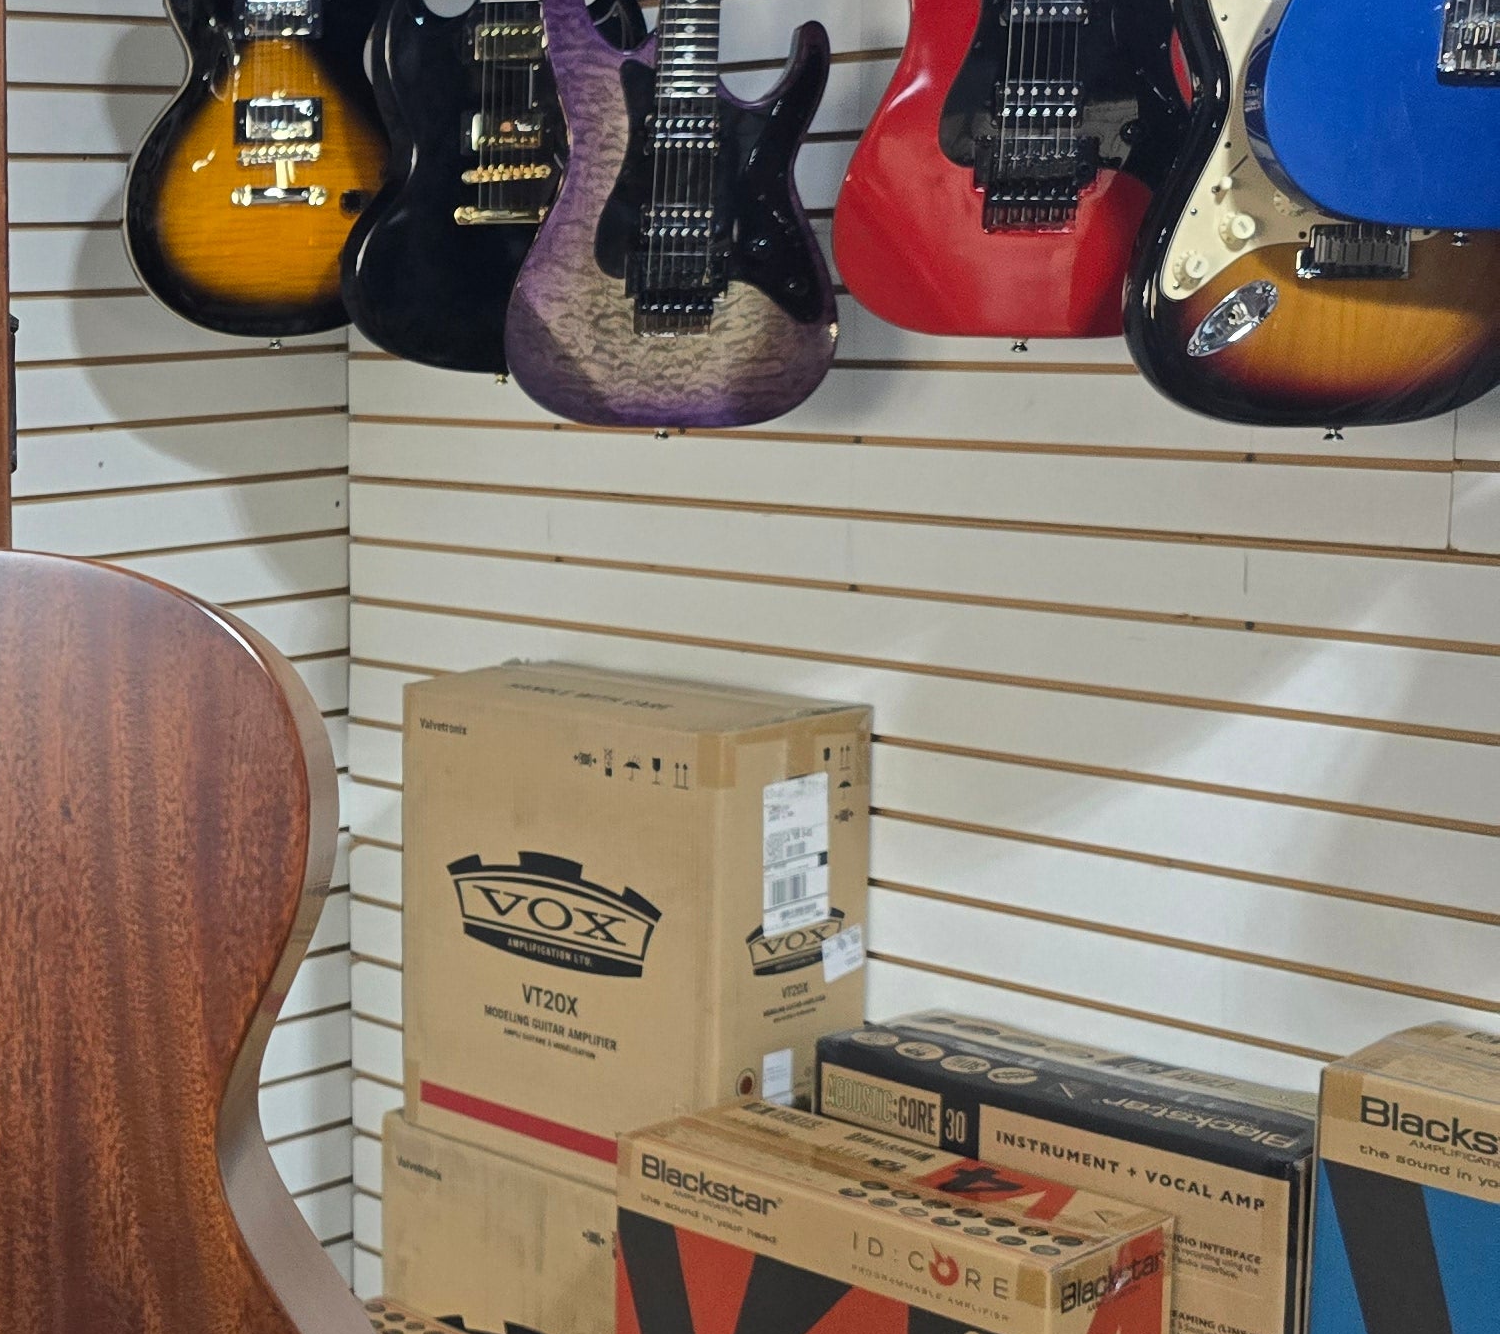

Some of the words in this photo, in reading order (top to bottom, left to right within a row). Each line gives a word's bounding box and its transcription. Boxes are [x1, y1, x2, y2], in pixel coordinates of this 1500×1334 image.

[420, 718, 467, 735] Valvetronix
[473, 885, 626, 946] VOX
[507, 938, 571, 962] AMPLIFICATION
[759, 925, 830, 956] VOX
[522, 983, 579, 1017] VT20X
[484, 1004, 529, 1027] MODELING
[532, 1018, 565, 1036] GUITAR
[568, 1029, 617, 1052] AMPLIFIER
[945, 1109, 967, 1144] 30
[1101, 1097, 1299, 1149] Blackstar
[1361, 1095, 1500, 1155] Blacks
[642, 1154, 778, 1215] Blackstar
[996, 1130, 1119, 1173] INSTRUMENT
[1127, 1166, 1137, 1177] +
[1145, 1169, 1212, 1199] VOCAL
[1220, 1190, 1266, 1212] AMP
[1359, 1144, 1389, 1160] the
[1396, 1155, 1451, 1176] sound
[1457, 1168, 1472, 1181] in
[1478, 1176, 1500, 1190] yo
[641, 1193, 660, 1206] the
[665, 1202, 698, 1218] sound
[717, 1219, 743, 1234] your
[748, 1228, 776, 1244] head
[1200, 1240, 1261, 1265] INTERFACE
[1171, 1309, 1215, 1330] EAMING
